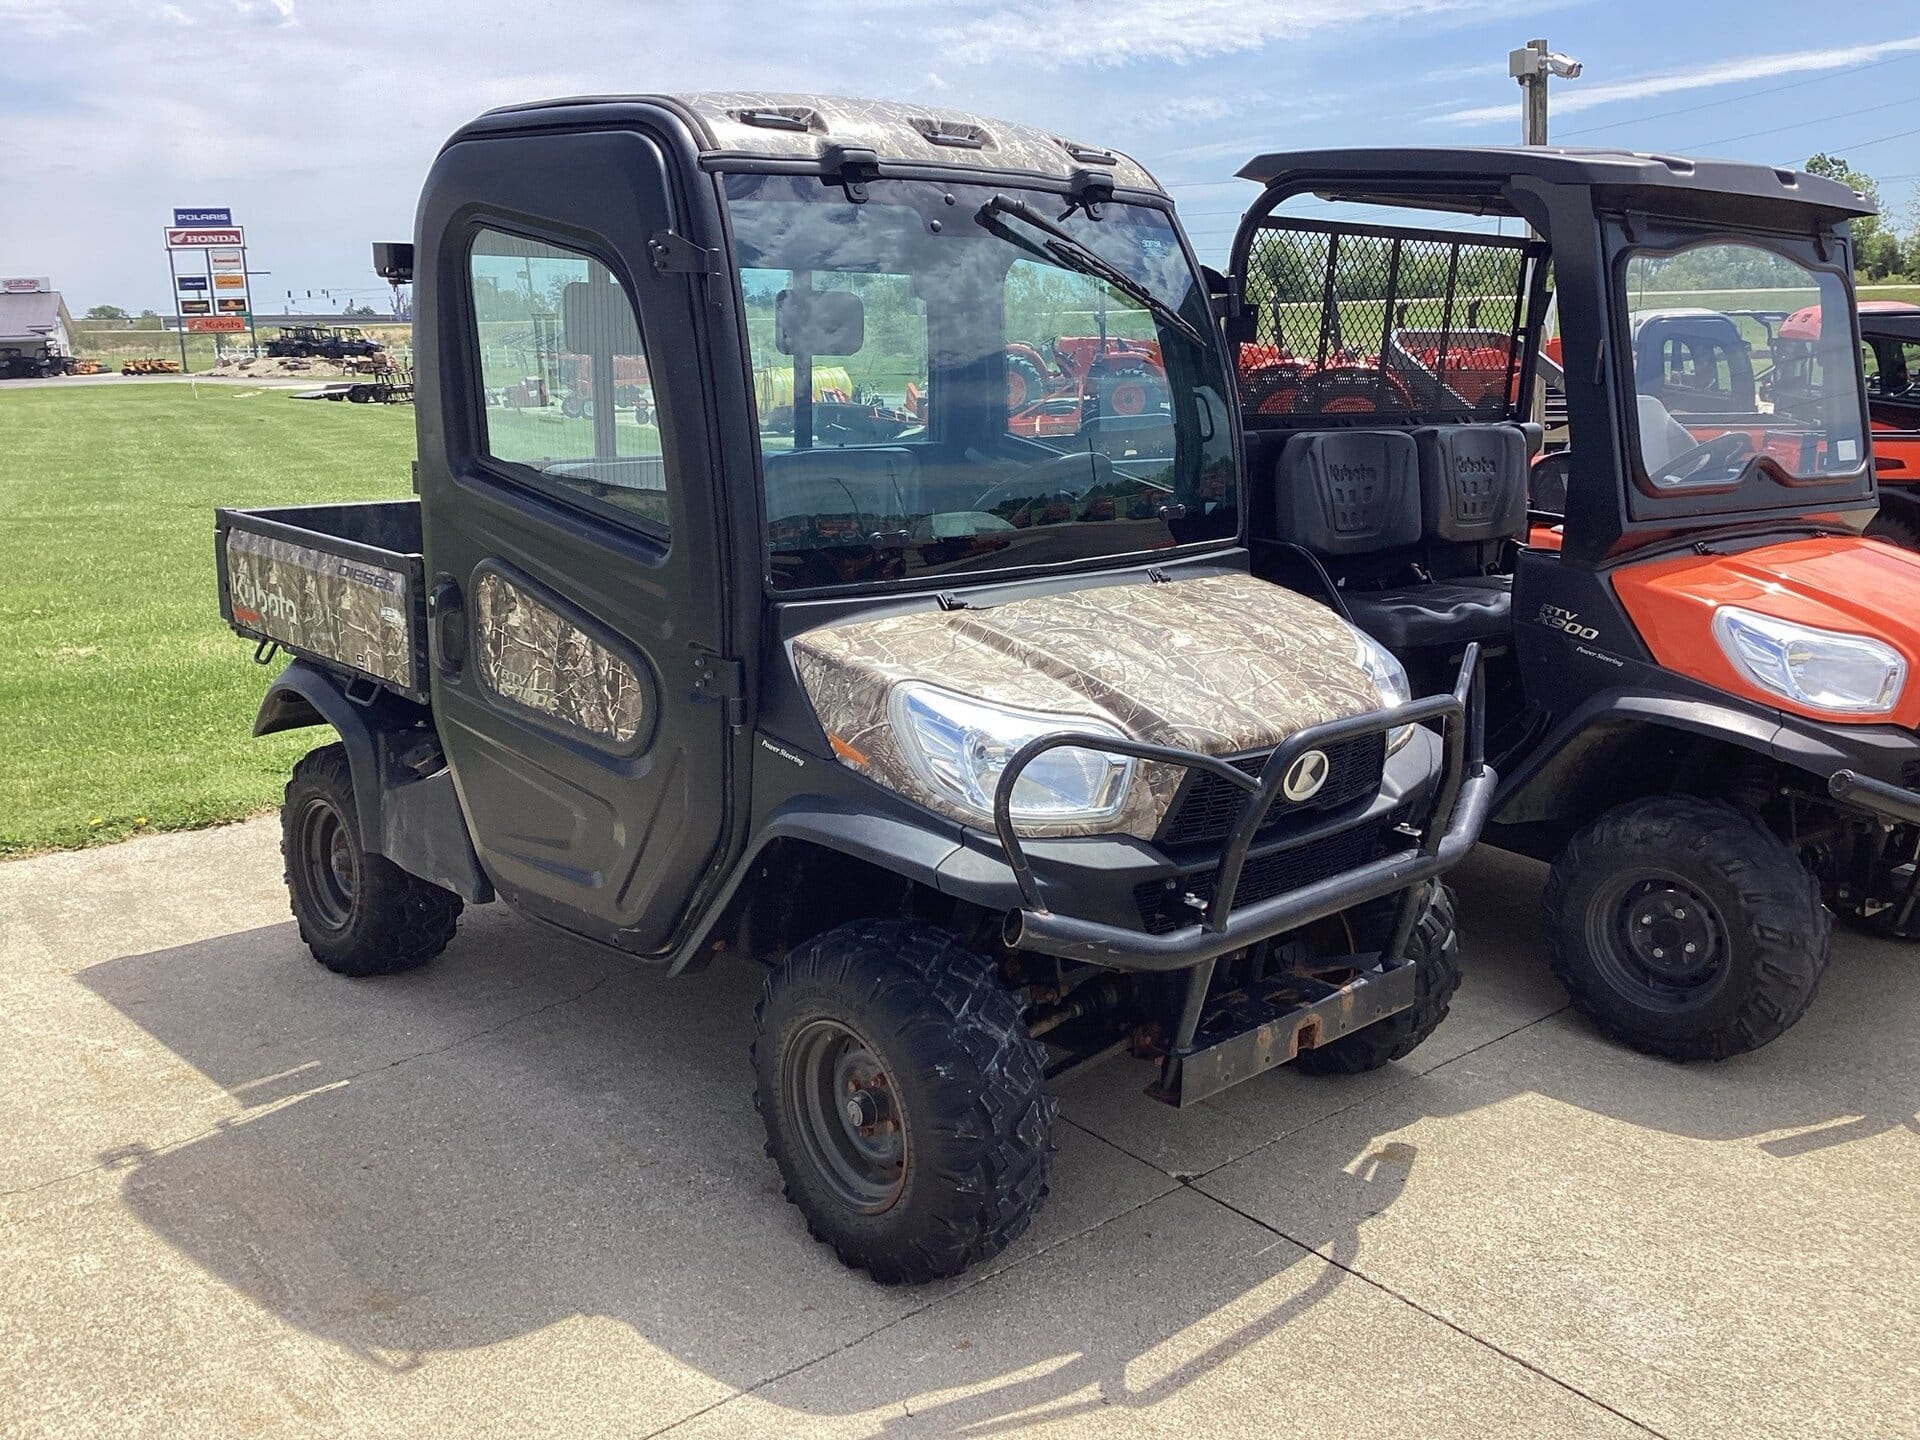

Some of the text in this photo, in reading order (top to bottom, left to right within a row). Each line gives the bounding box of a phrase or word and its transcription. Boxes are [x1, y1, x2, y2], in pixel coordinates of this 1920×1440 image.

[178, 214, 228, 222] POLARIS
[186, 235, 240, 244] HONDA
[205, 320, 241, 330] Kubota
[338, 564, 395, 592] DIESEL
[231, 571, 298, 625] Kubota
[1539, 603, 1579, 621] RTV
[1534, 611, 1600, 640] X900
[1576, 645, 1624, 668] Power Steering
[761, 739, 805, 767] Power Steering
